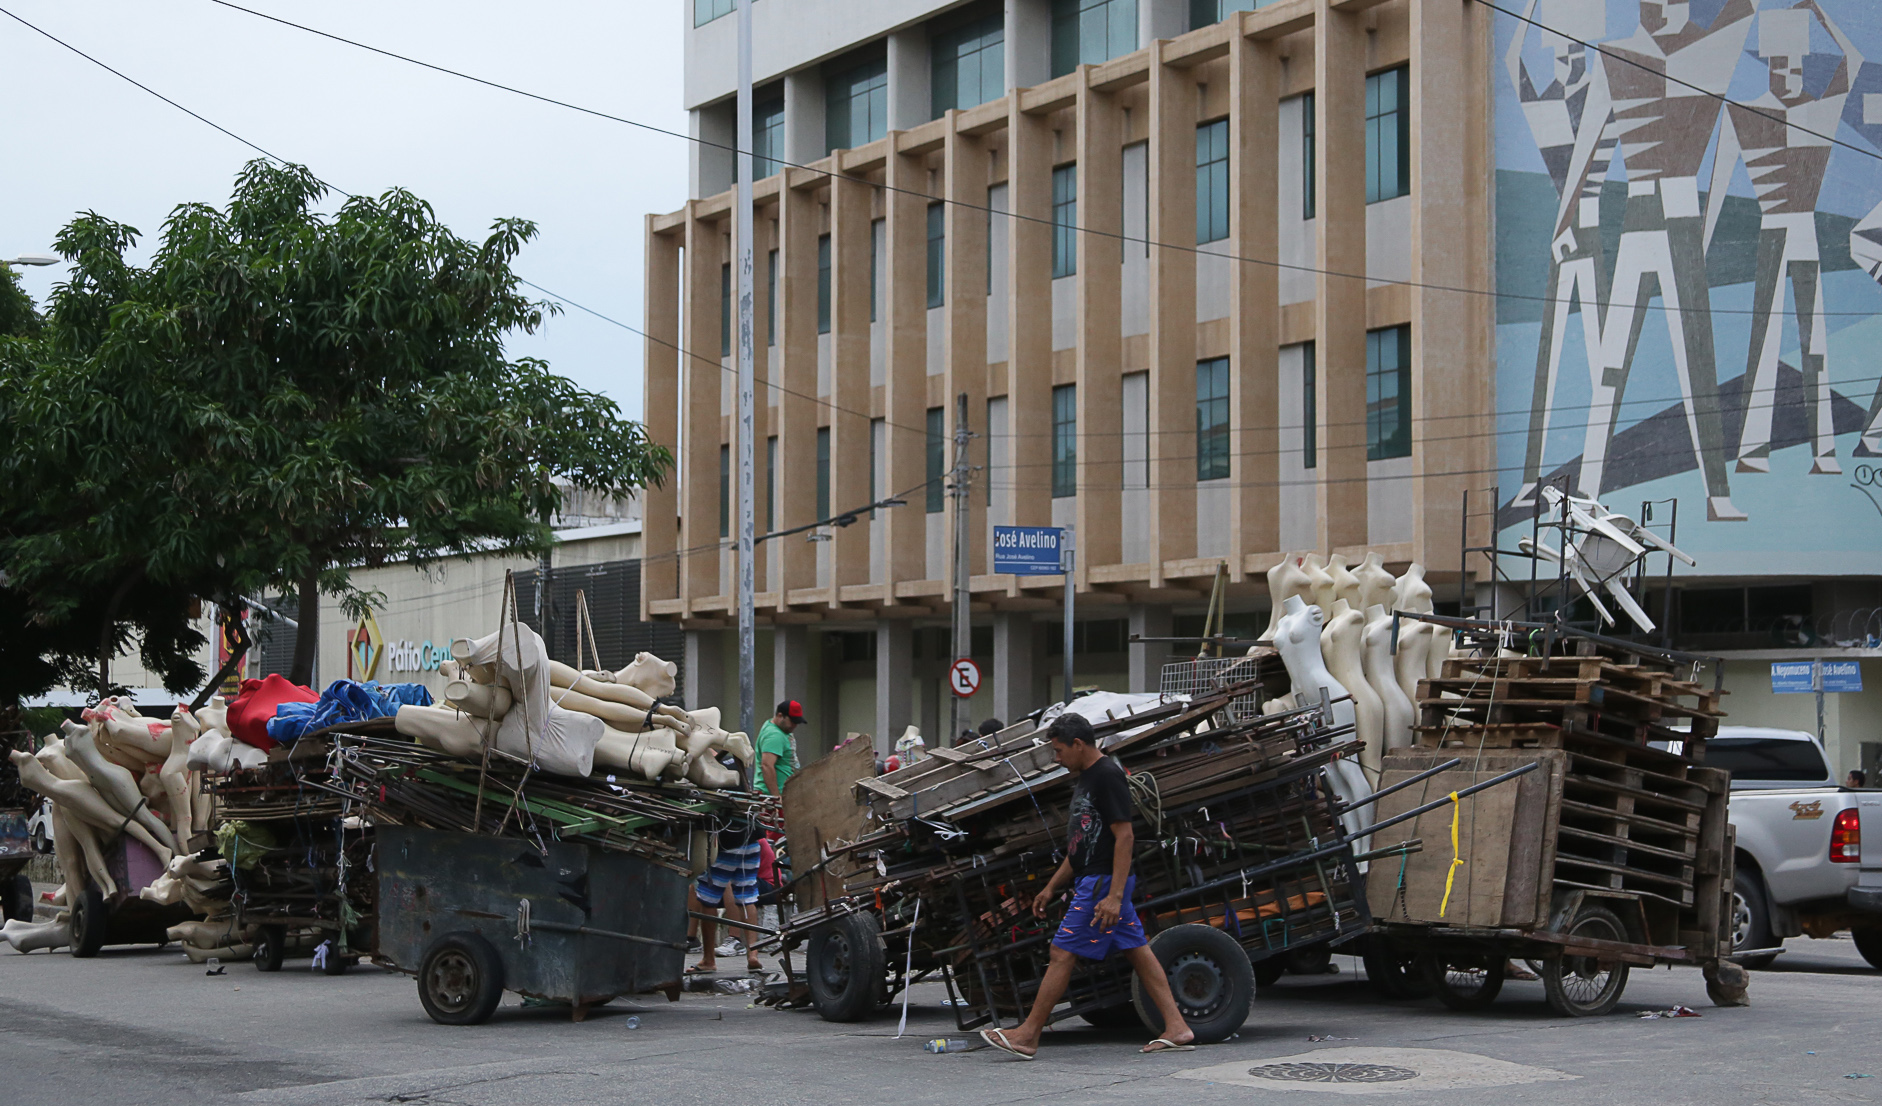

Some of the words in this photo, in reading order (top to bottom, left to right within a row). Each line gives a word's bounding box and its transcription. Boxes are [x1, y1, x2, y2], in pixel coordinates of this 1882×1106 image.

[995, 530, 1017, 547] José
[1019, 531, 1057, 549] Avelino
[960, 668, 971, 687] E
[1833, 663, 1857, 676] Avelino
